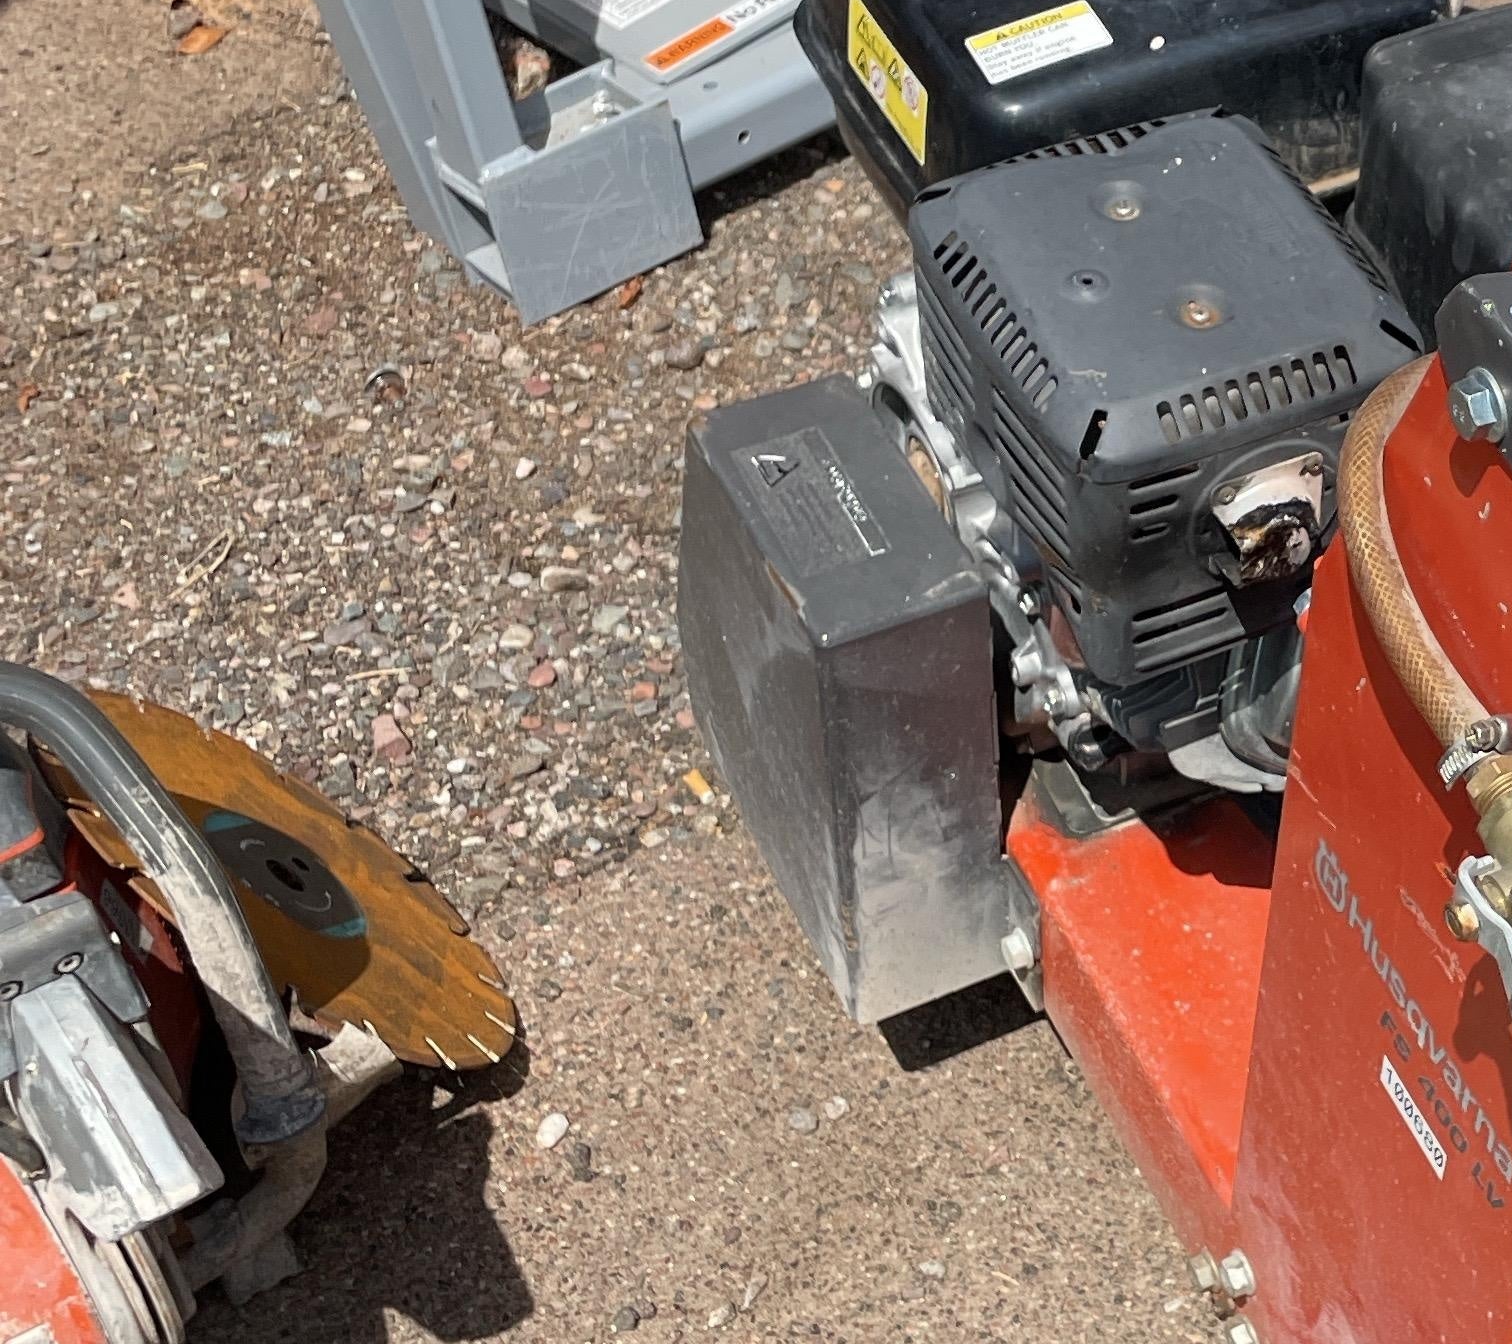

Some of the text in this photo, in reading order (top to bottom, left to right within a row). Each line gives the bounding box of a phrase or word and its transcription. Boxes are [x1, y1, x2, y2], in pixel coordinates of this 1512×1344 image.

[1009, 12, 1063, 36] CAUTION
[1385, 1066, 1444, 1169] 100680
[1418, 1075, 1468, 1153] 400
[1472, 1161, 1505, 1208] LV
